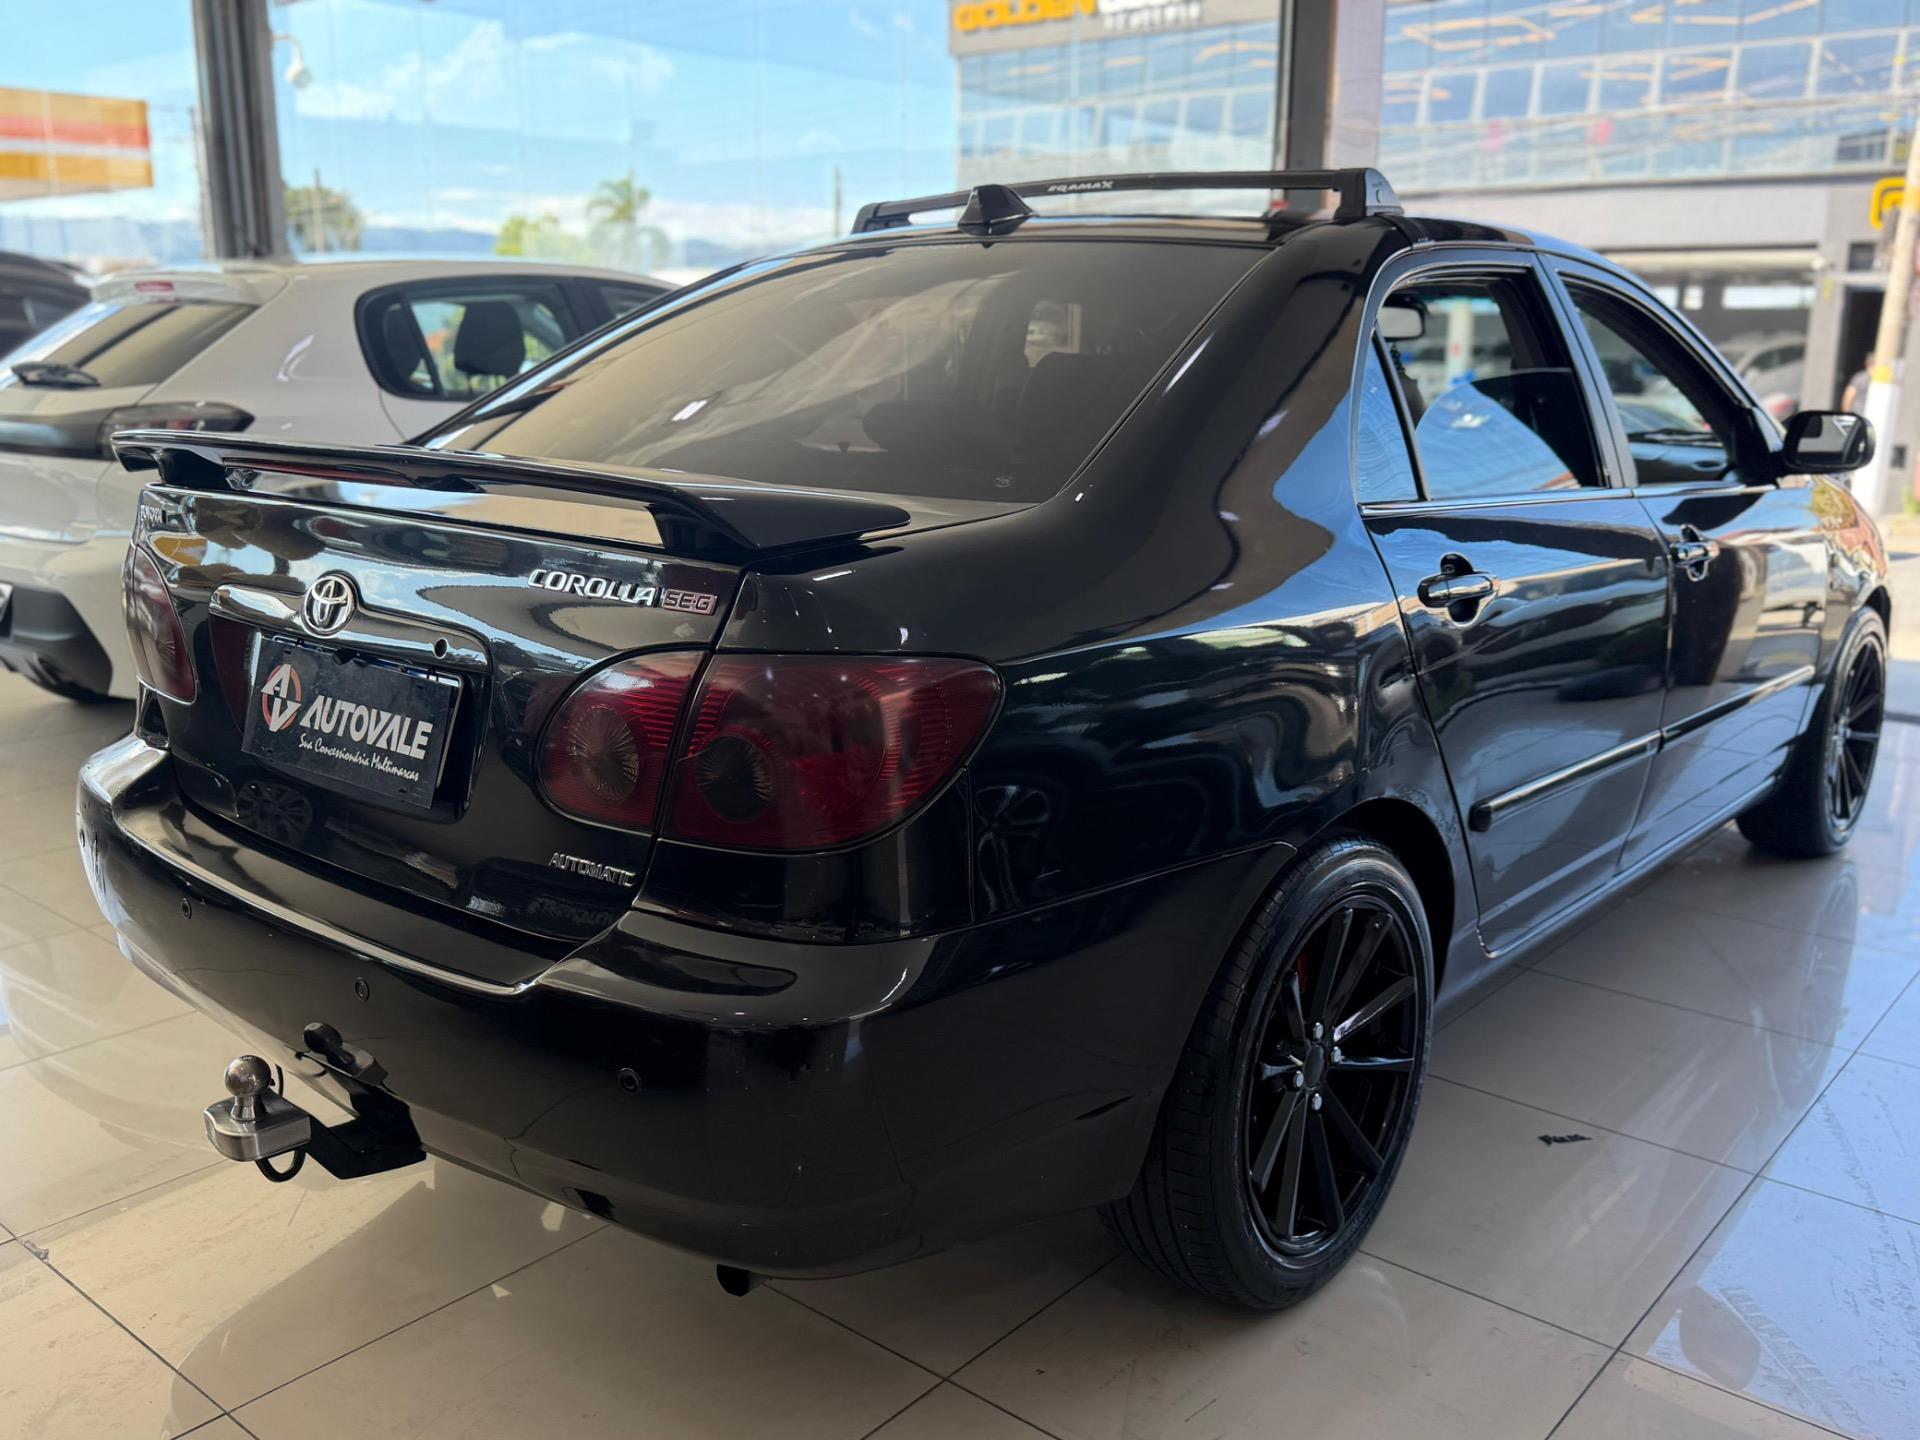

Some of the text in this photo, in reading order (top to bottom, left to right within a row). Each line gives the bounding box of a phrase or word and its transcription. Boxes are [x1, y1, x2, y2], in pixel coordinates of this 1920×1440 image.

[527, 568, 657, 608] COROLLA
[299, 694, 434, 761] AUTOVALE
[298, 732, 420, 782] Sua Concessionária Multimarcas
[548, 851, 637, 888] AUTOMATIC
